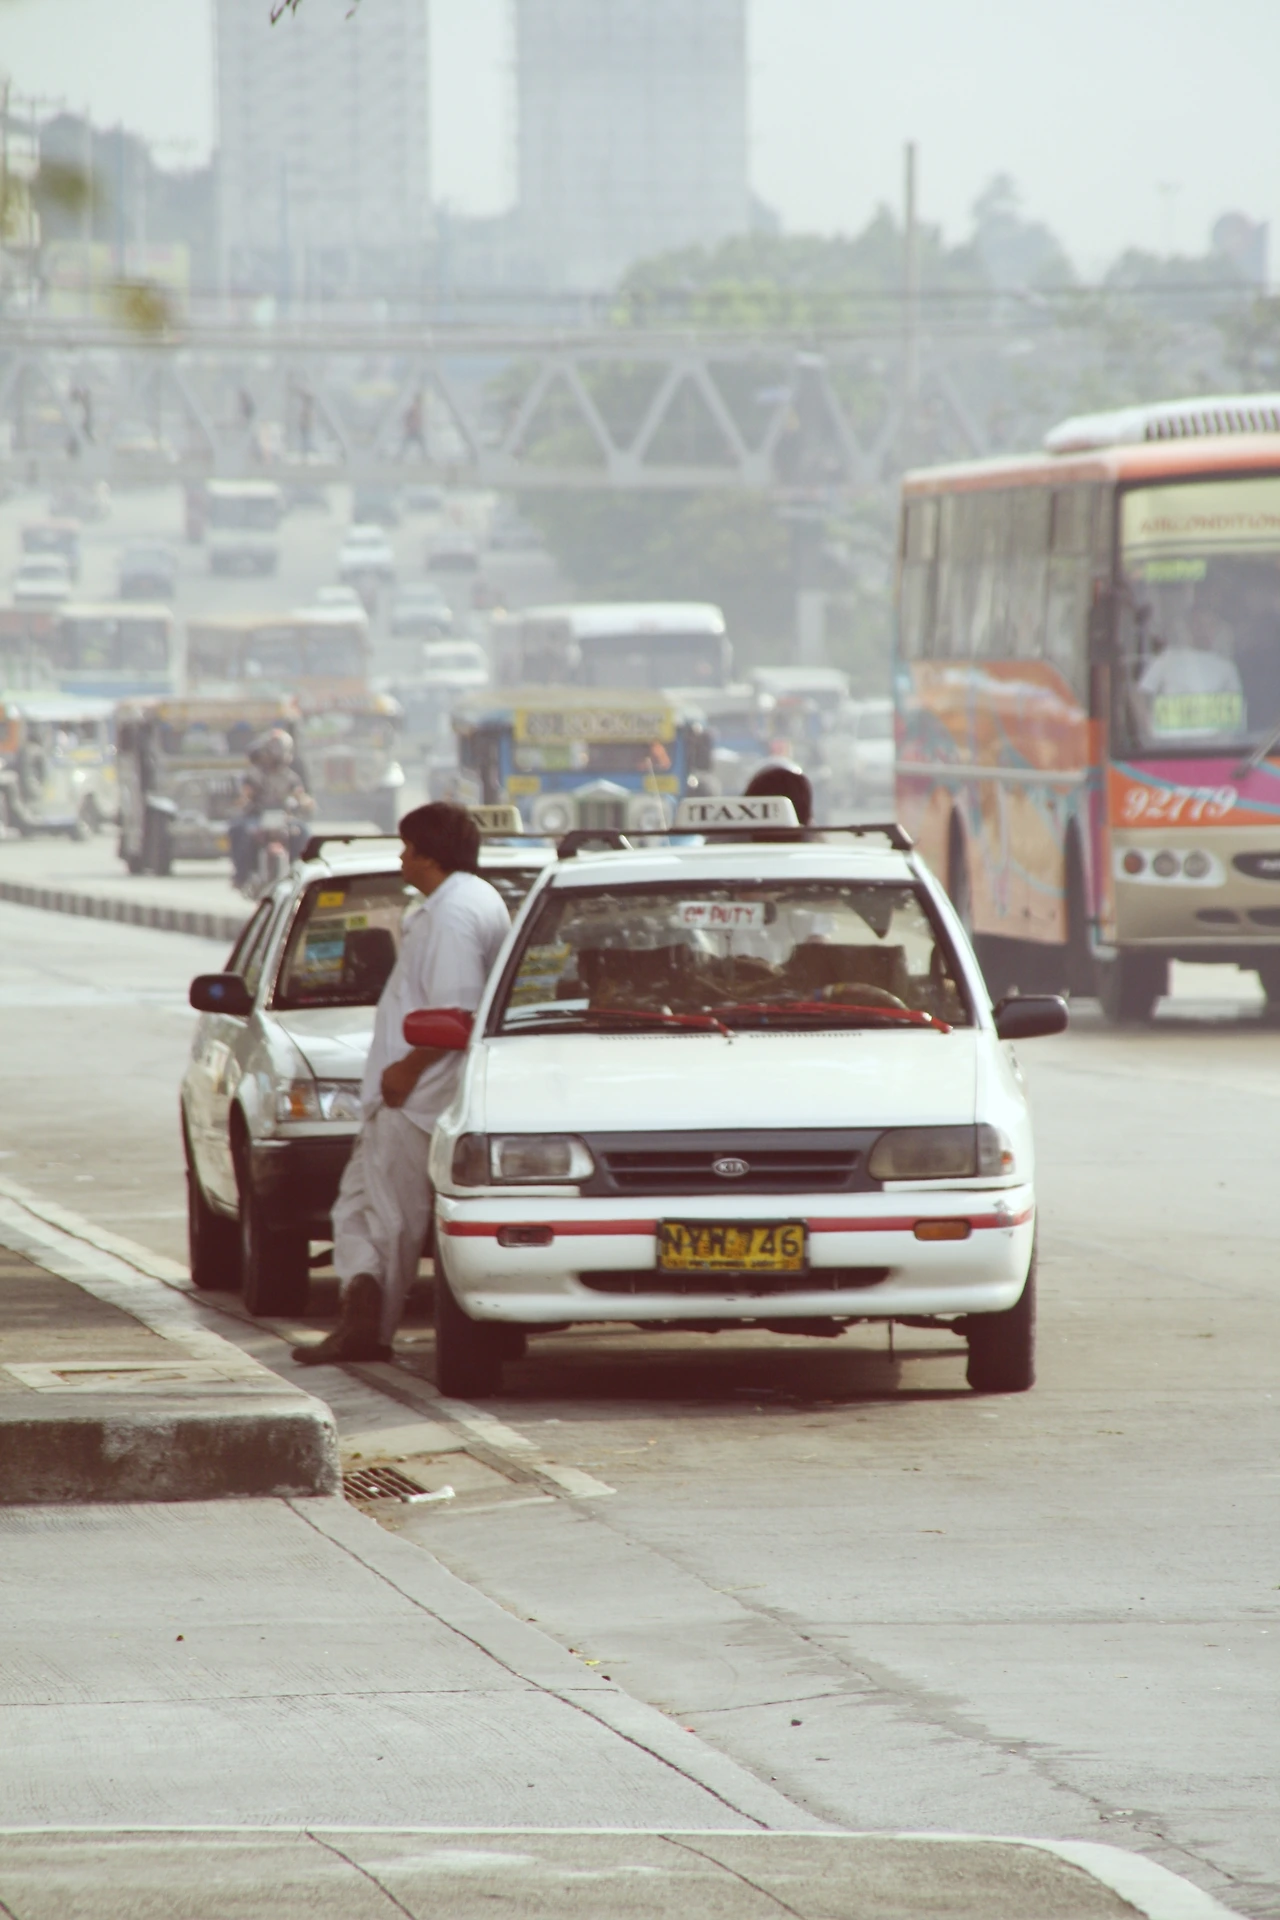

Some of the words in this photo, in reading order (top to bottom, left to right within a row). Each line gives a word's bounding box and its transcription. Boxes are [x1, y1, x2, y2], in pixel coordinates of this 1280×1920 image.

[692, 802, 772, 822] TAXI
[1124, 785, 1238, 821] 92779
[710, 905, 754, 925] DUTY
[718, 1161, 746, 1173] KIA
[736, 1227, 799, 1257] 746
